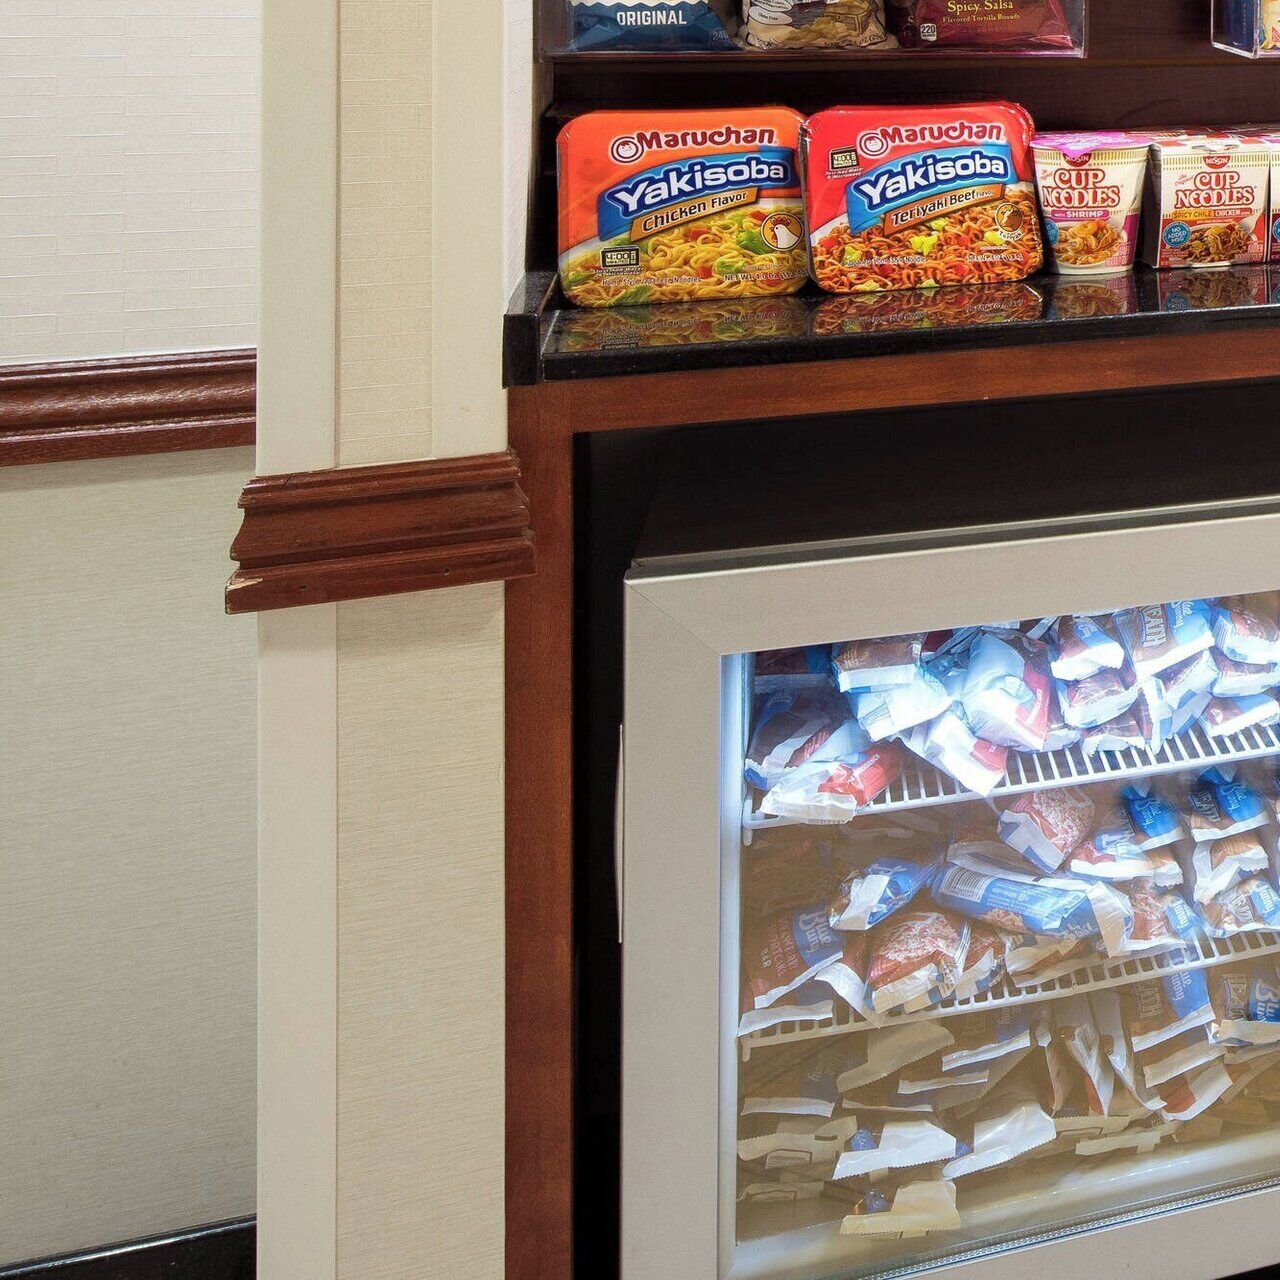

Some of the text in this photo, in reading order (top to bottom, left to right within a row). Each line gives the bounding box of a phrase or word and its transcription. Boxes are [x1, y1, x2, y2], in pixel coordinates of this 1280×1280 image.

[616, 9, 688, 26] ORIGINAL
[947, 0, 981, 13] Spicy
[637, 127, 776, 151] Maruchan
[884, 122, 1004, 145] Maruchan
[615, 156, 785, 214] Yakisoba
[859, 152, 1005, 206] Yakisoba
[1053, 169, 1105, 190] CUP
[1194, 171, 1240, 190] CUP
[892, 189, 976, 226] Teriyaki Beef
[1042, 185, 1121, 208] NOODLES
[1175, 187, 1255, 208] NOODLES
[642, 190, 748, 231] Chicken Flavor
[1066, 210, 1104, 218] SHRIMP
